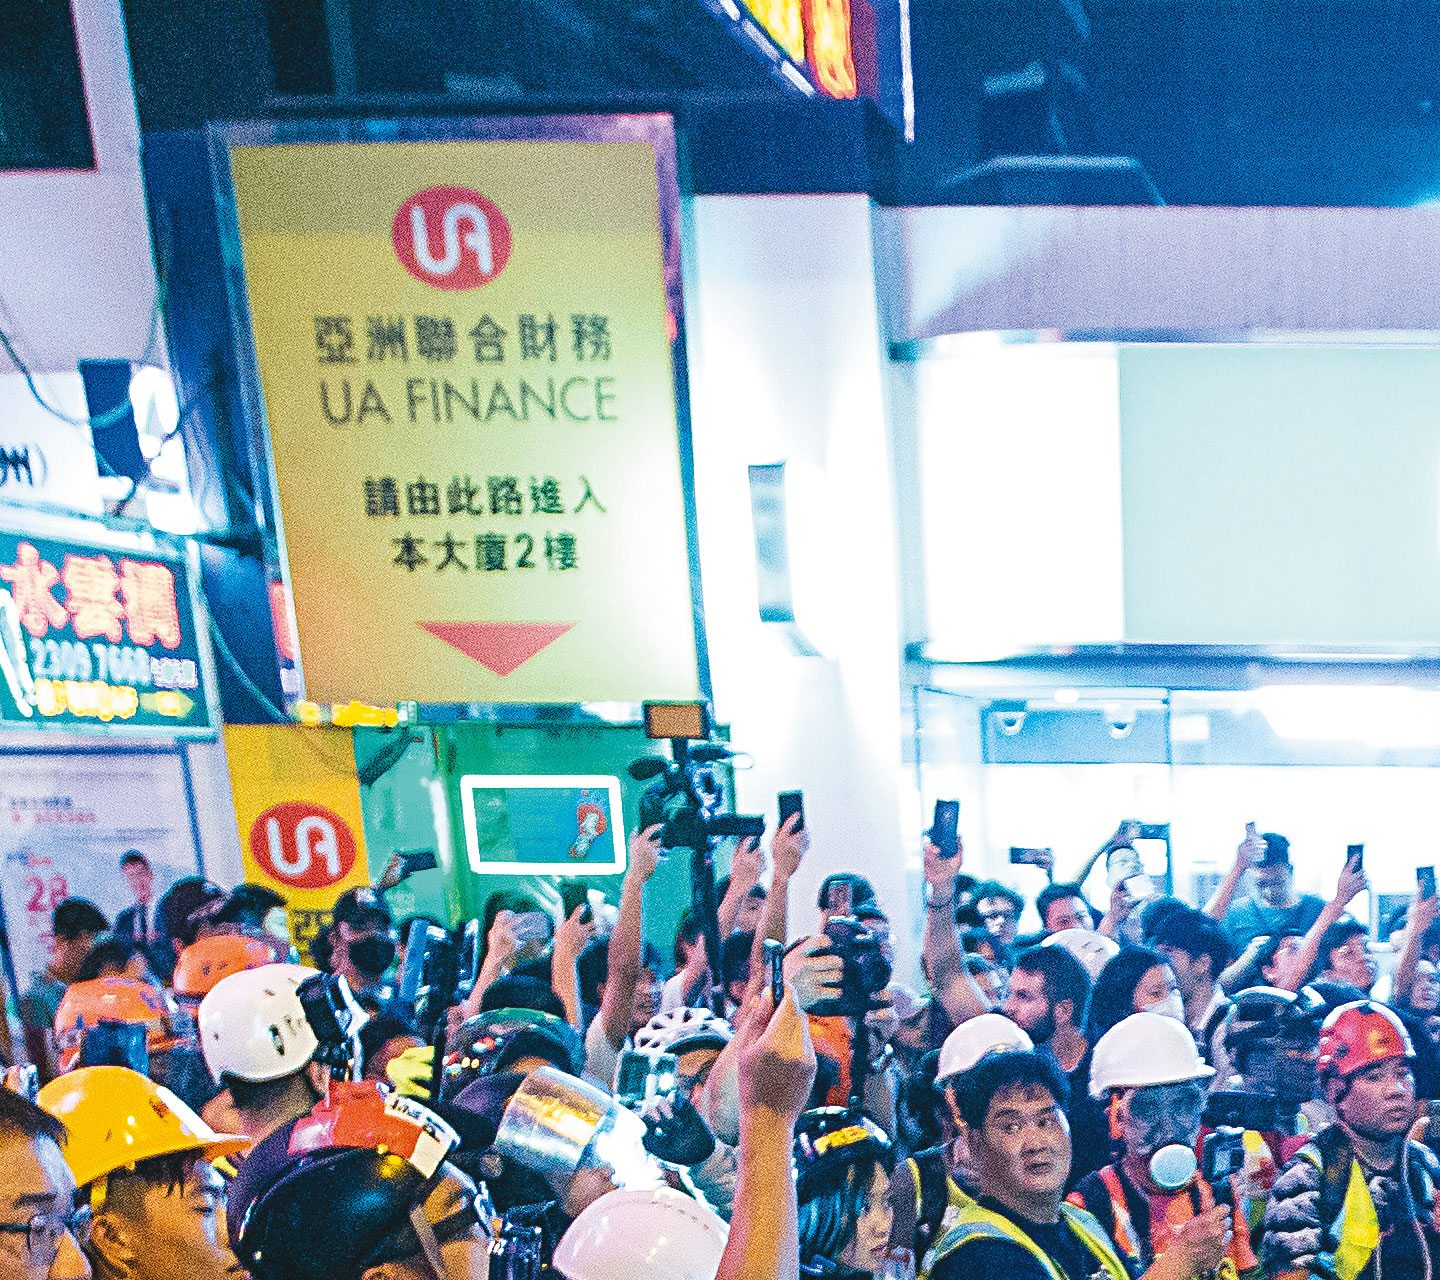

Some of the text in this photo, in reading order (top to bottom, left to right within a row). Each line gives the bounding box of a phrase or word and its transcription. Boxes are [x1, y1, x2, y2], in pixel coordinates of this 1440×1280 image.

[410, 201, 493, 278] UA
[314, 313, 613, 366] 亞洲聯合財務
[317, 375, 619, 427] UA FINANCE
[362, 475, 608, 518] 請由此路進入
[392, 532, 579, 572] 本大廈2樓
[266, 816, 341, 878] UA
